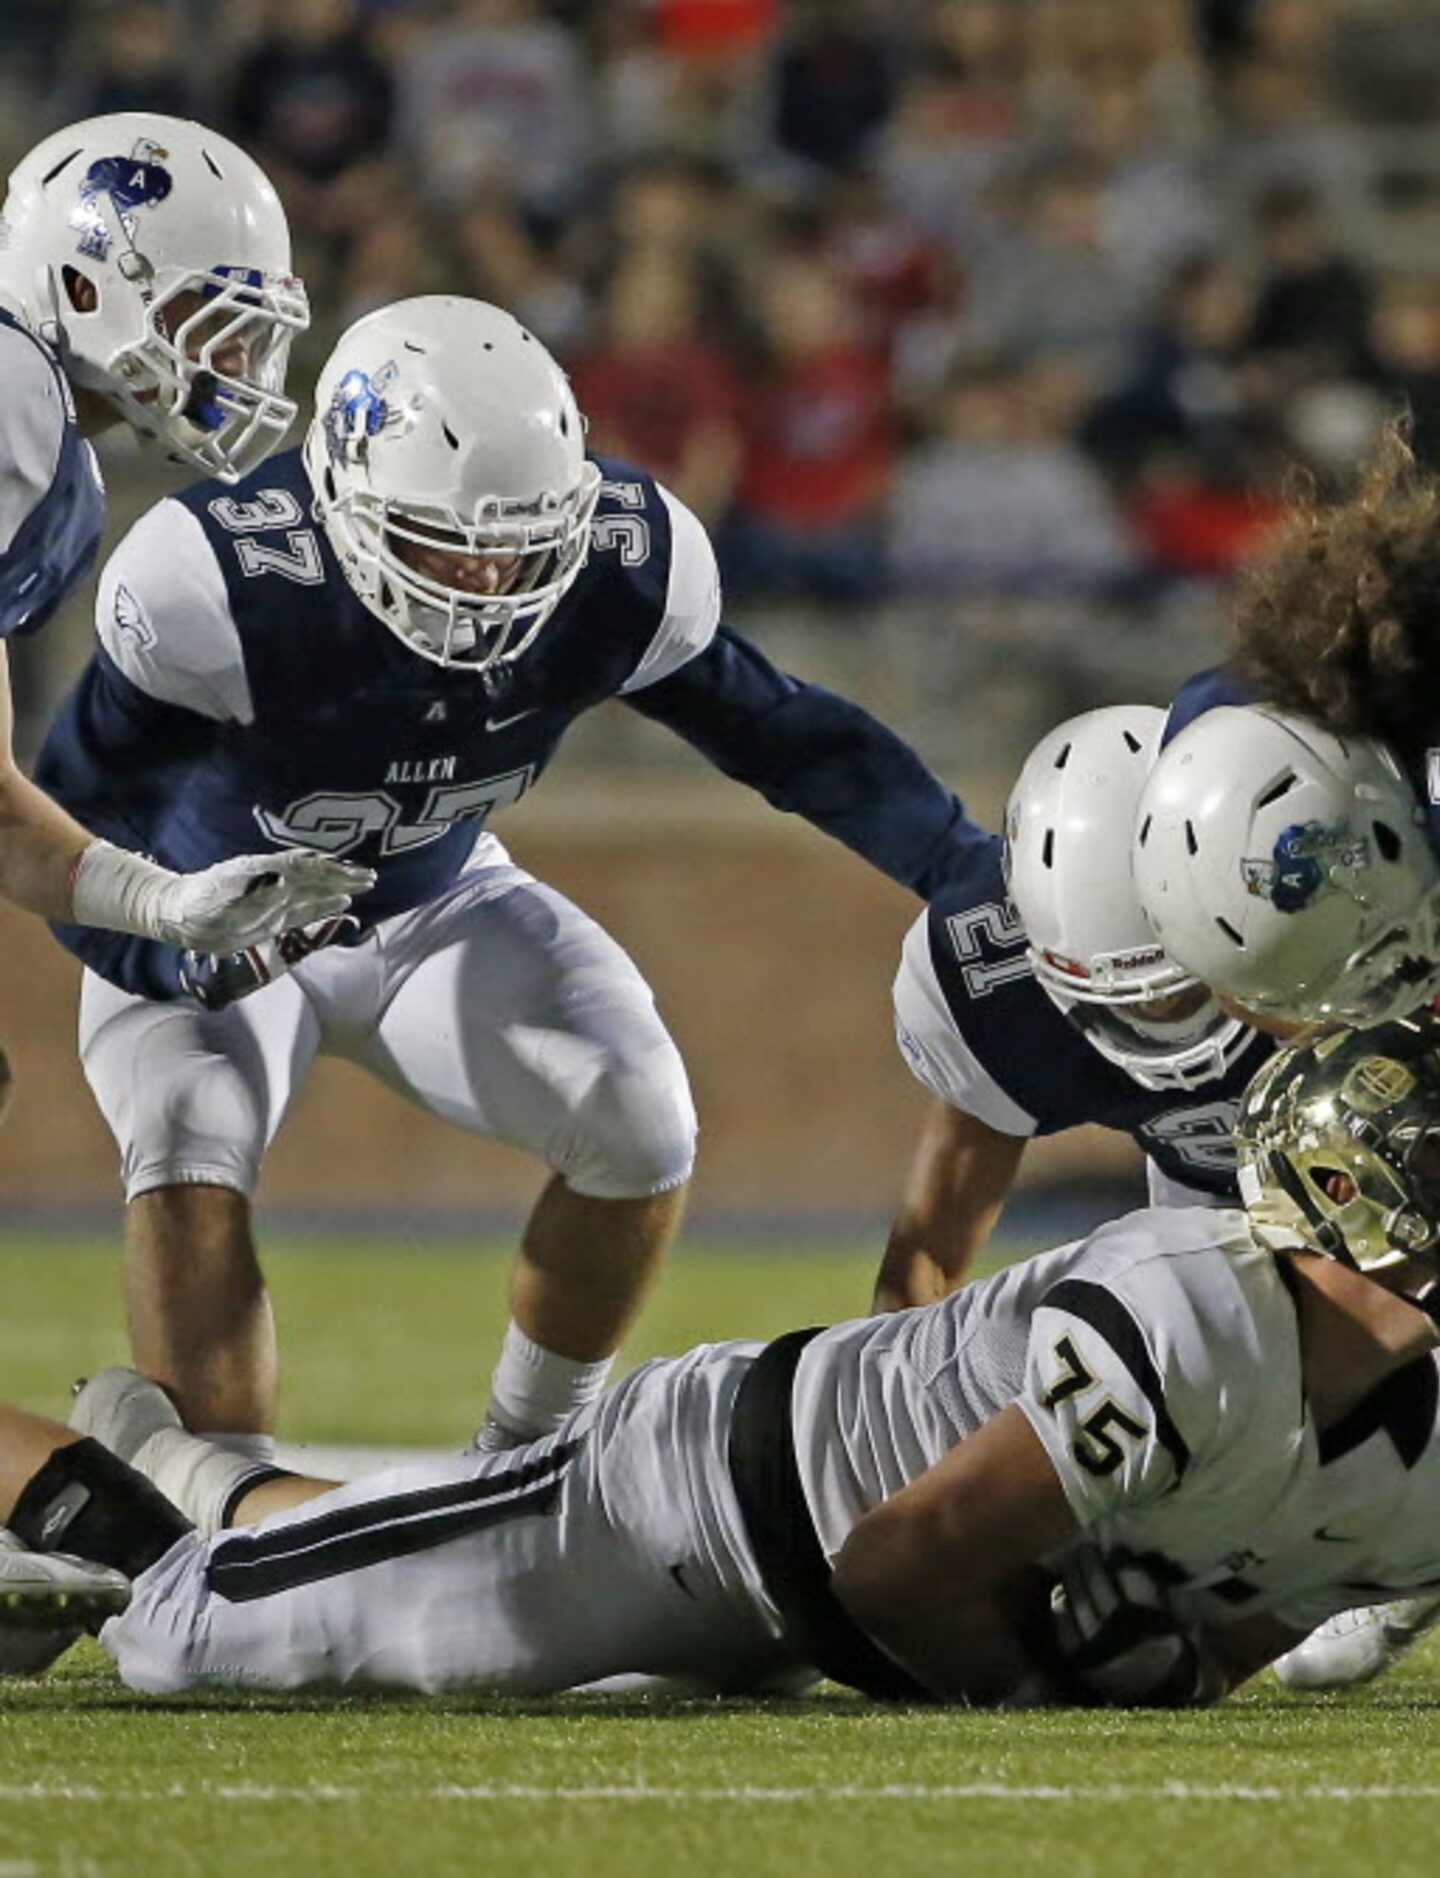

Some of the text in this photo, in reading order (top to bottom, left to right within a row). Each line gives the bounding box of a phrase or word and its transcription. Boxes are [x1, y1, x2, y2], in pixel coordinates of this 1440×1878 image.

[128, 168, 146, 189] A
[207, 488, 326, 585] 37
[384, 756, 457, 784] ALLEN
[945, 902, 1035, 1000] 21
[1038, 1328, 1151, 1477] 75
